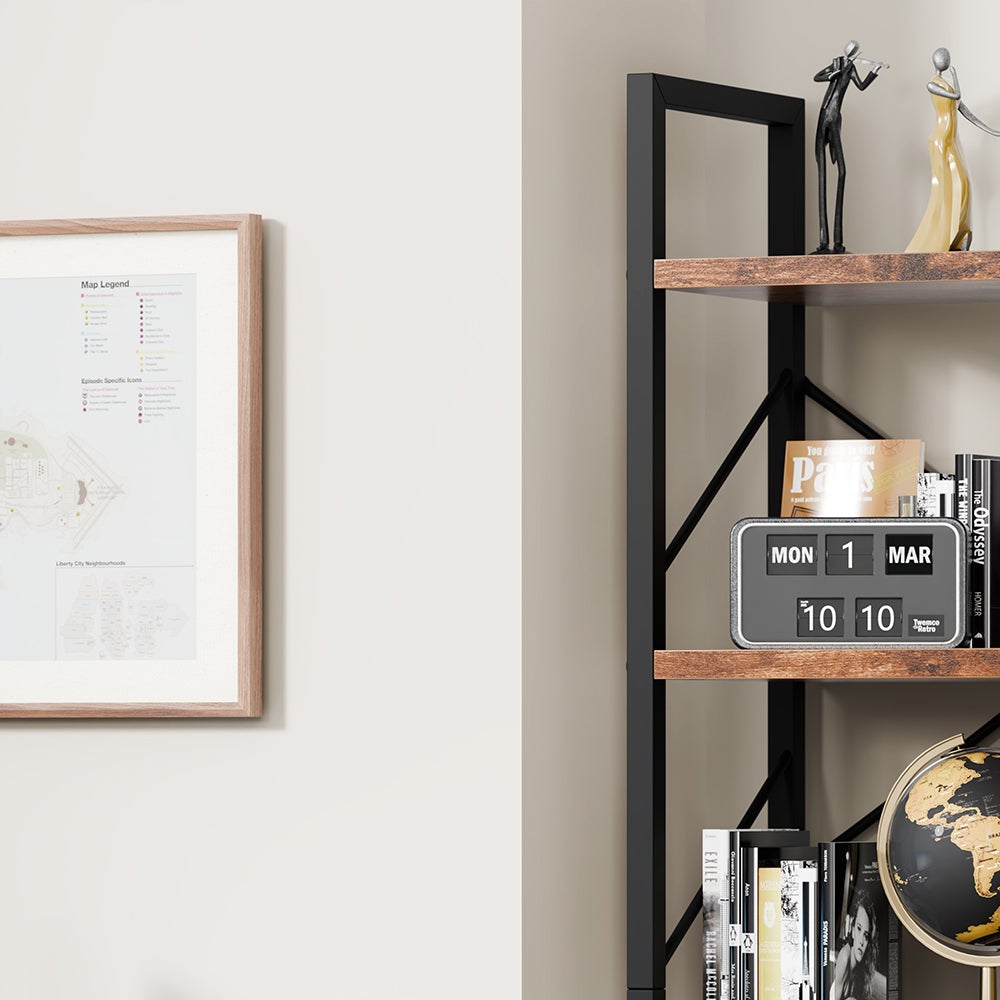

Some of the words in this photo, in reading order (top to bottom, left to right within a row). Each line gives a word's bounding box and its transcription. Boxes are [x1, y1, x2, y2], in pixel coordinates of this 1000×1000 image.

[81, 281, 98, 290] Map
[100, 280, 130, 289] Legend
[790, 457, 875, 493] Pas
[958, 478, 968, 497] THE
[974, 489, 984, 505] The
[973, 507, 989, 565] Odyssey
[771, 546, 814, 564] MON
[842, 541, 853, 569] 1
[888, 546, 932, 564] MAR
[974, 592, 982, 617] HOMER
[803, 605, 837, 631] 10
[861, 605, 895, 631] 10
[913, 618, 940, 626] Twemco
[704, 851, 718, 882] EXILE
[706, 931, 717, 964] RACHEL
